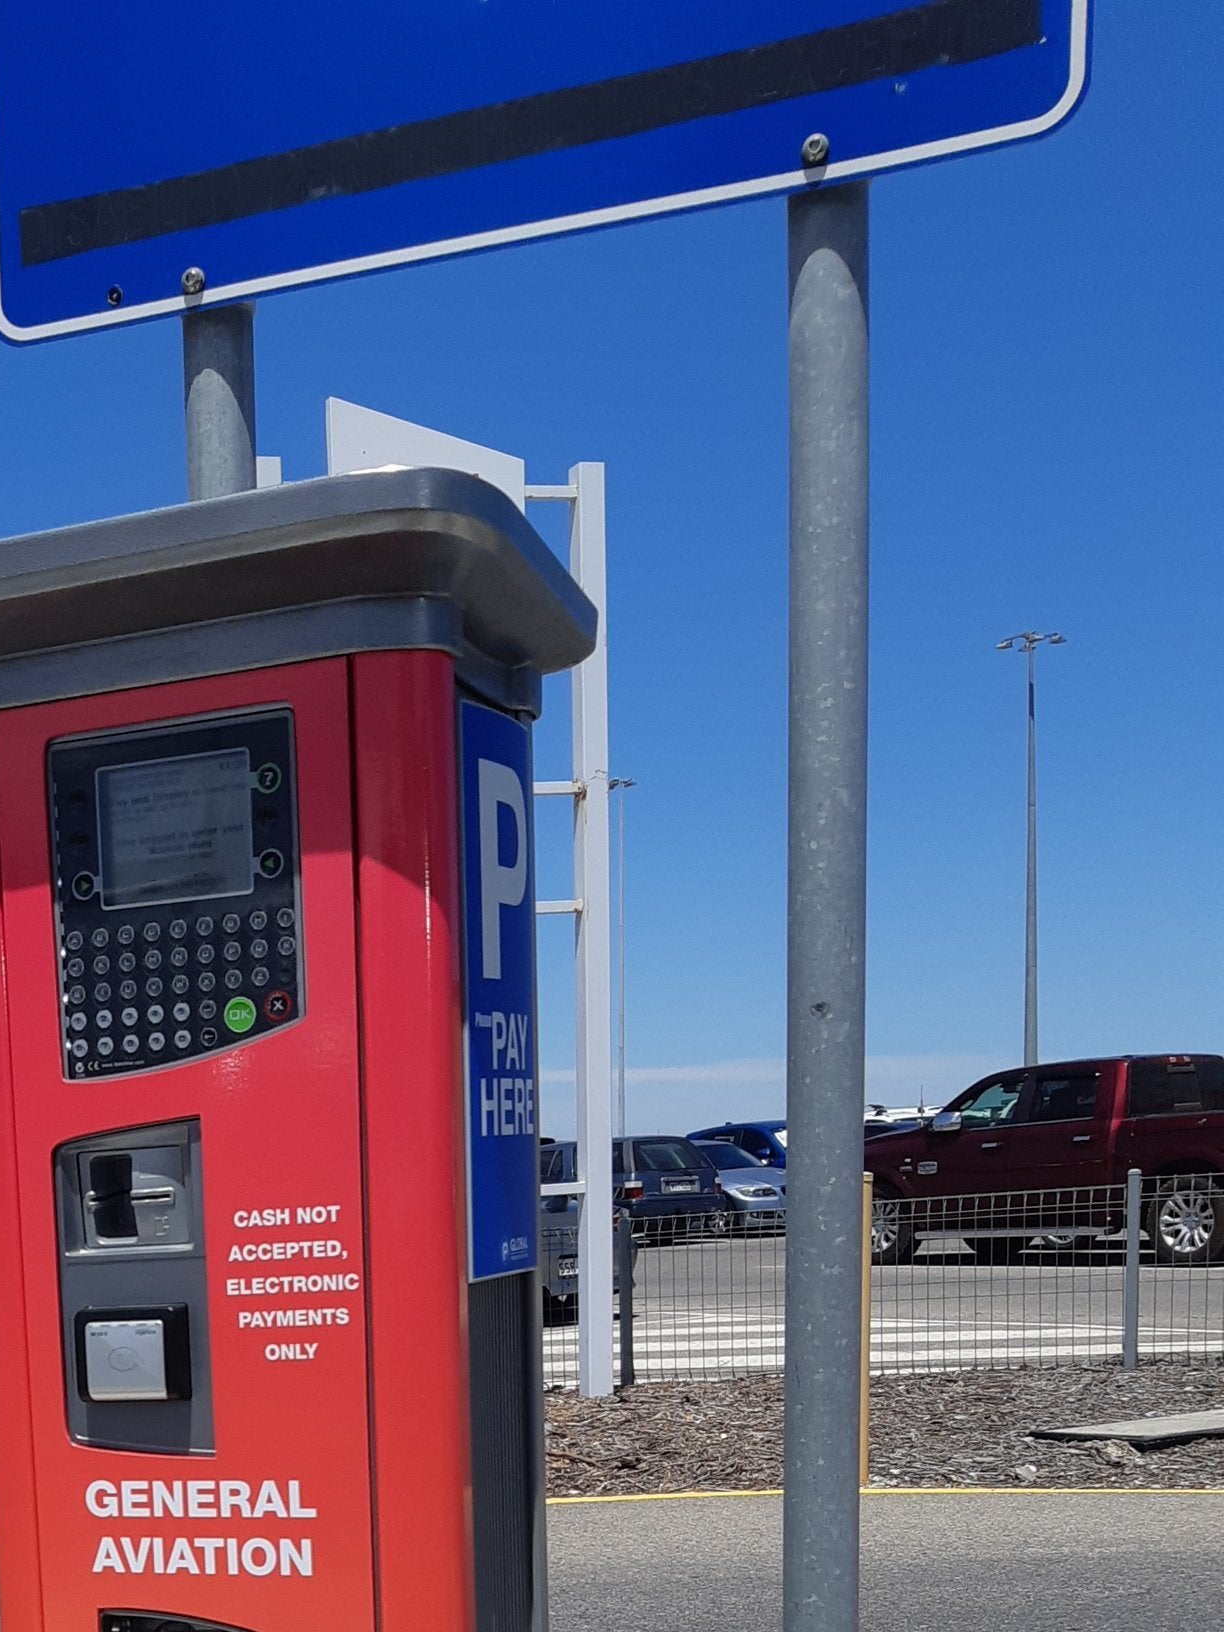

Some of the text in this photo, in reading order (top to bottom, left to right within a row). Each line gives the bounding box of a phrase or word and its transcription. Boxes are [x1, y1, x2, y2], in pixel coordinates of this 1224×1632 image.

[478, 758, 528, 980] P
[229, 1008, 251, 1020] OK
[491, 1011, 528, 1071] PAY
[480, 1077, 534, 1137] HERE
[233, 1204, 340, 1228] CASH NOT
[228, 1240, 349, 1263] ACCEPTED,
[226, 1273, 360, 1297] ELECTRONIC
[238, 1307, 350, 1329] PAYMENTS
[264, 1343, 318, 1361] ONLY
[84, 1479, 317, 1519] GENERAL
[91, 1536, 313, 1577] AVIATION
